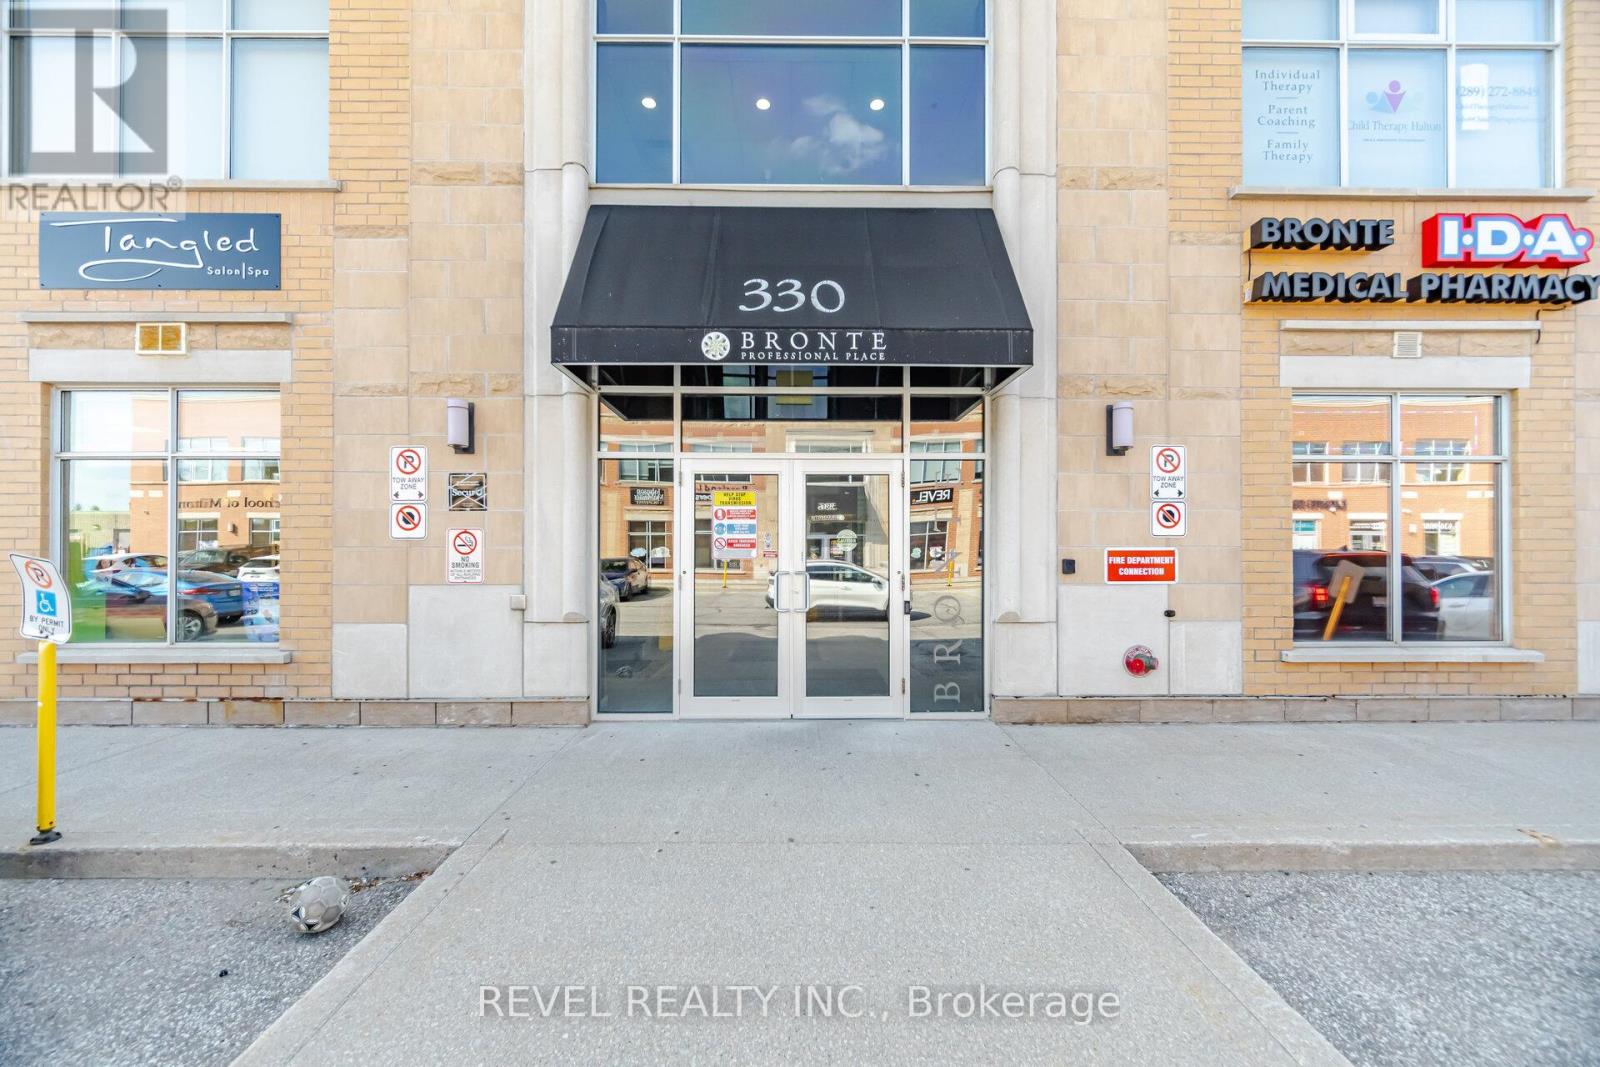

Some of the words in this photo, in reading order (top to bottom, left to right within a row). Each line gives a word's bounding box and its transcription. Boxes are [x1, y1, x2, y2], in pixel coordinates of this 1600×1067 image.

[1255, 69, 1320, 79] Individual
[1263, 81, 1312, 94] Therapy
[1268, 104, 1308, 114] Parent
[1257, 115, 1316, 128] Coaching
[1372, 120, 1408, 133] Therapy
[1411, 120, 1442, 131] Halton
[1267, 139, 1309, 152] Family
[1263, 151, 1312, 164] Therapy
[1254, 218, 1395, 248] BRONTE
[1257, 272, 1408, 300] MEDICAL
[1416, 273, 1600, 301] PHARMACY
[738, 278, 846, 313] 330
[741, 331, 887, 350] BRONTE
[741, 352, 839, 361] PROFESSIONAL
[846, 352, 886, 361] PLACE
[1109, 556, 1125, 564] FIRE
[1127, 556, 1174, 564] DEPARTMENT
[1118, 567, 1165, 575] CONNECTION
[29, 614, 38, 622] BY
[41, 617, 64, 628] PERMIT
